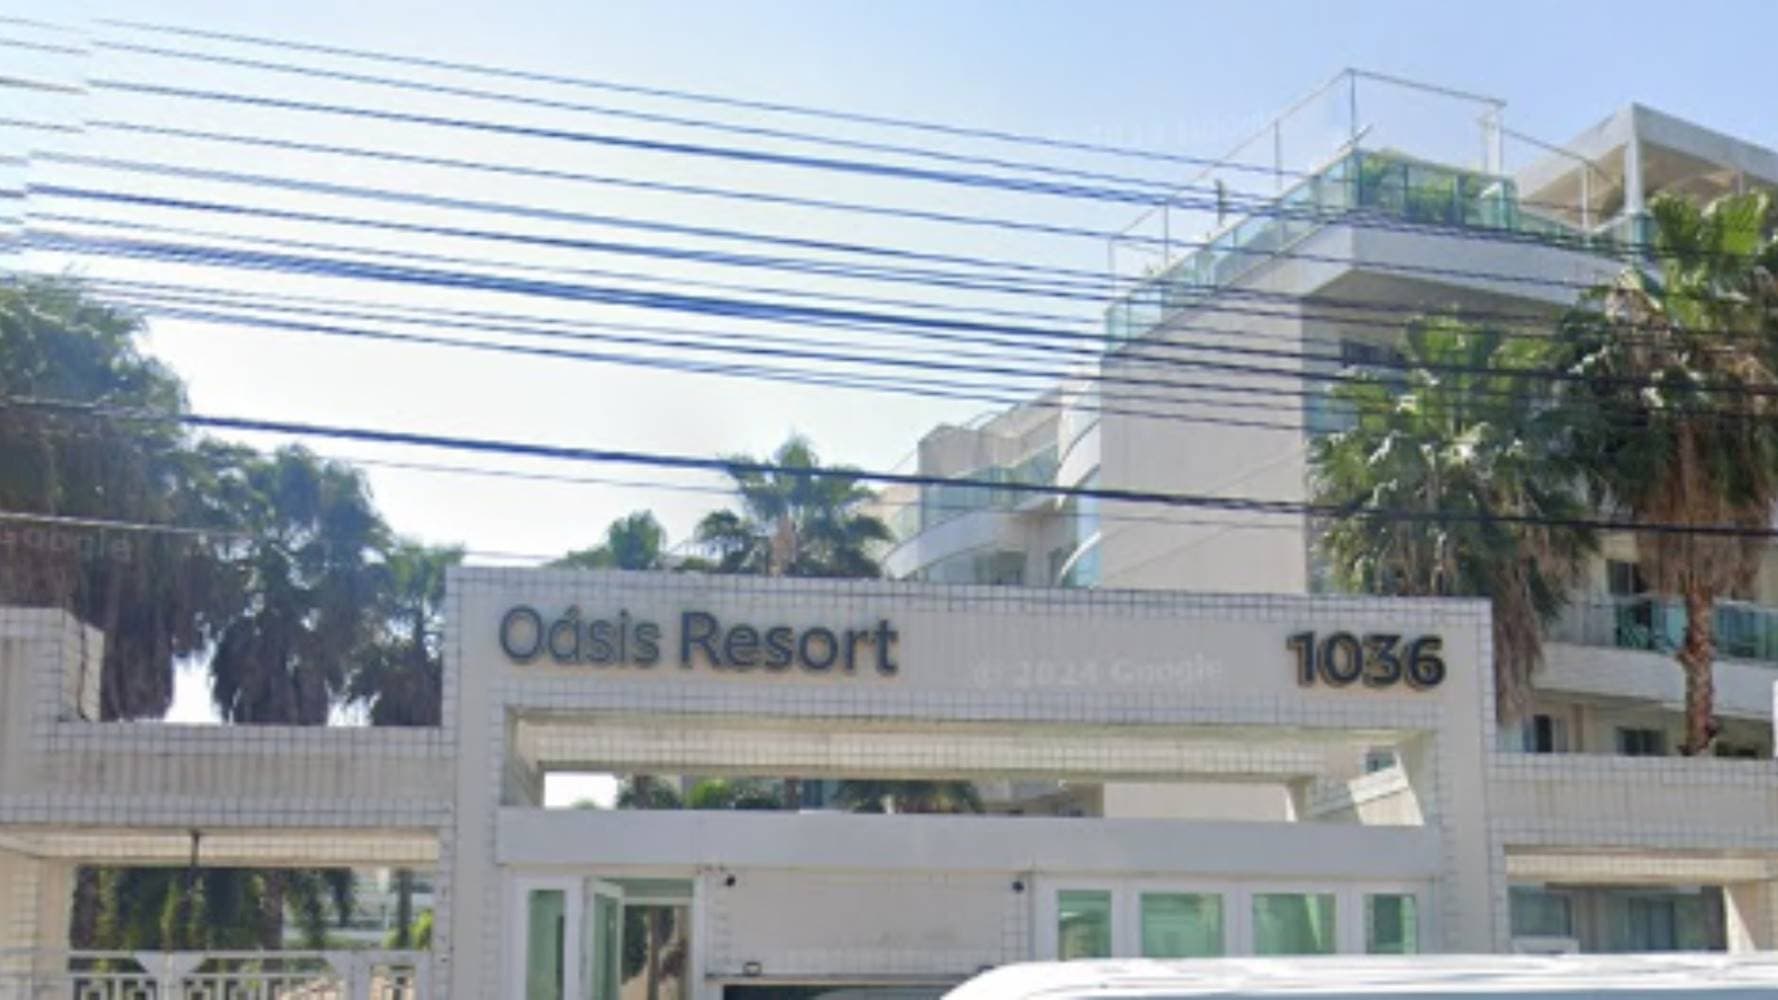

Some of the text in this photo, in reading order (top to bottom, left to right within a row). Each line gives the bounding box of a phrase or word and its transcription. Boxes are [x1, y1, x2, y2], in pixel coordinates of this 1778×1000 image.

[499, 604, 899, 677] Oásis Resort
[1286, 630, 1447, 691] 1036
